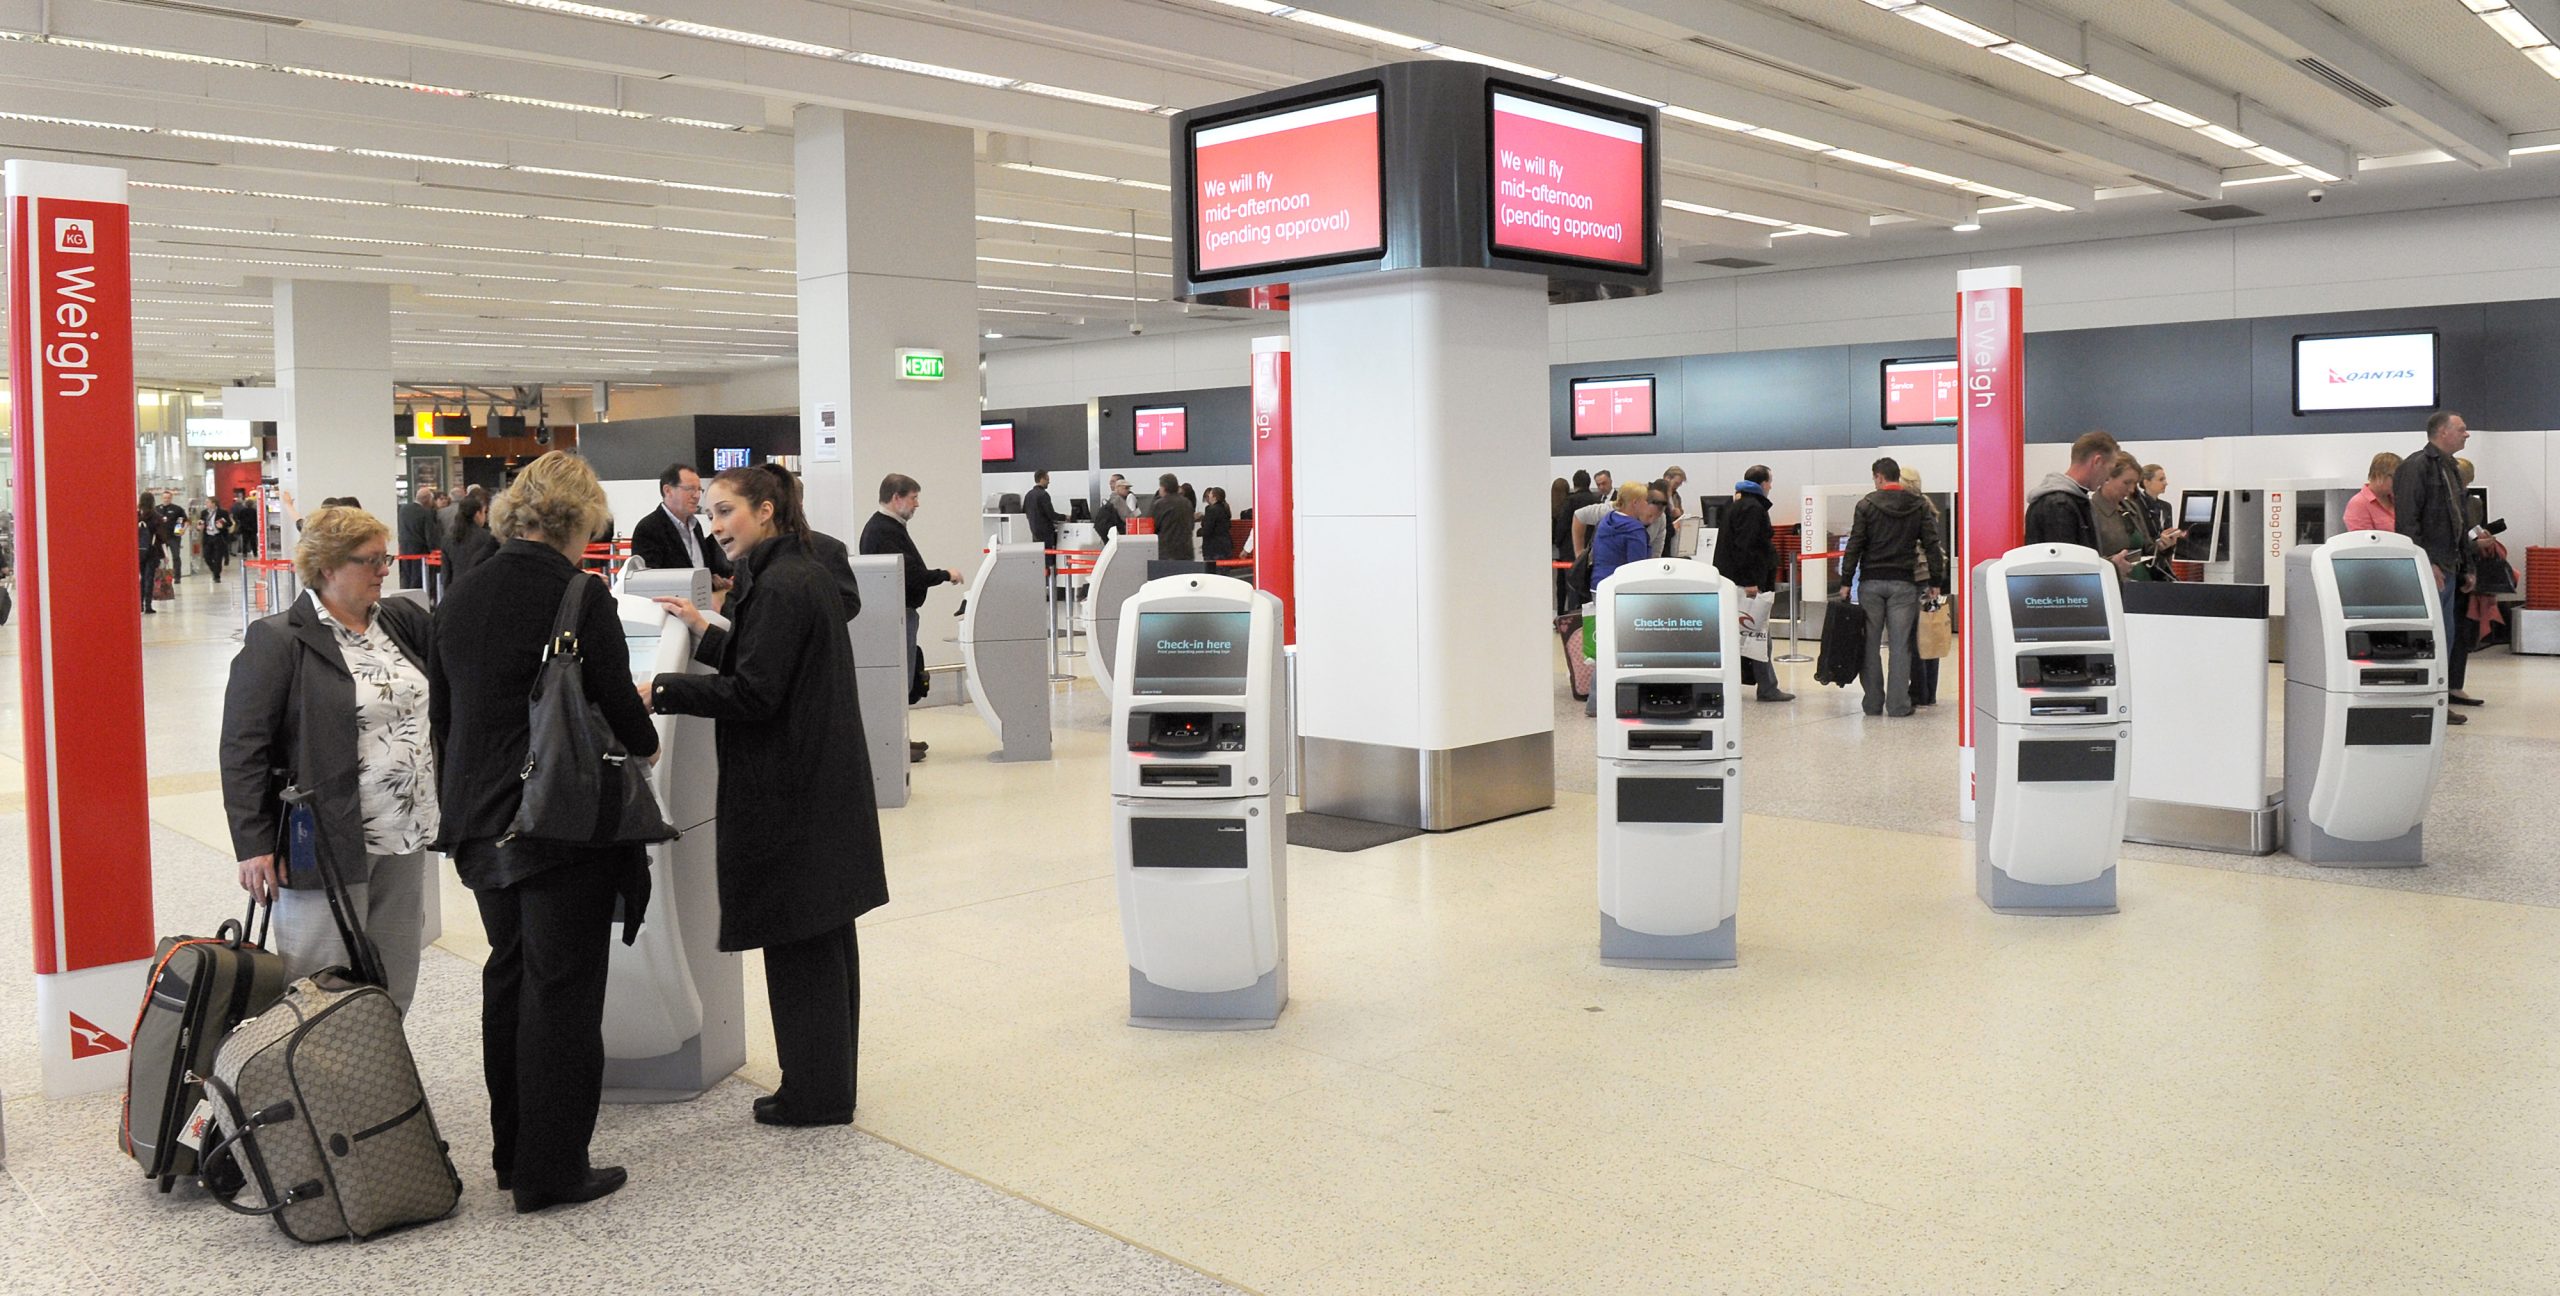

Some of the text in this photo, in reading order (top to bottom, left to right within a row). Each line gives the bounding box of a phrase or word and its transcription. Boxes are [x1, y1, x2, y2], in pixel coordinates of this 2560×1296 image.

[1501, 149, 1563, 183] We will fly
[1204, 171, 1273, 198] We will fly
[1501, 178, 1593, 210] mid-afternoon
[1205, 193, 1310, 223] mid-afternoon
[1501, 203, 1622, 243] (pending approval)
[66, 234, 84, 245] KG
[1206, 209, 1350, 252] (pending approval)
[46, 265, 99, 397] Weigh
[912, 359, 937, 374] EXIT
[1969, 327, 1997, 407] Weigh
[2346, 369, 2415, 381] QANTAS
[1804, 508, 1813, 551] Bag Drop
[2269, 505, 2282, 557] Bag Drop
[2024, 596, 2088, 605] Check-in here
[1633, 617, 1703, 627] Check-in here
[1157, 640, 1231, 649] Check-in here
